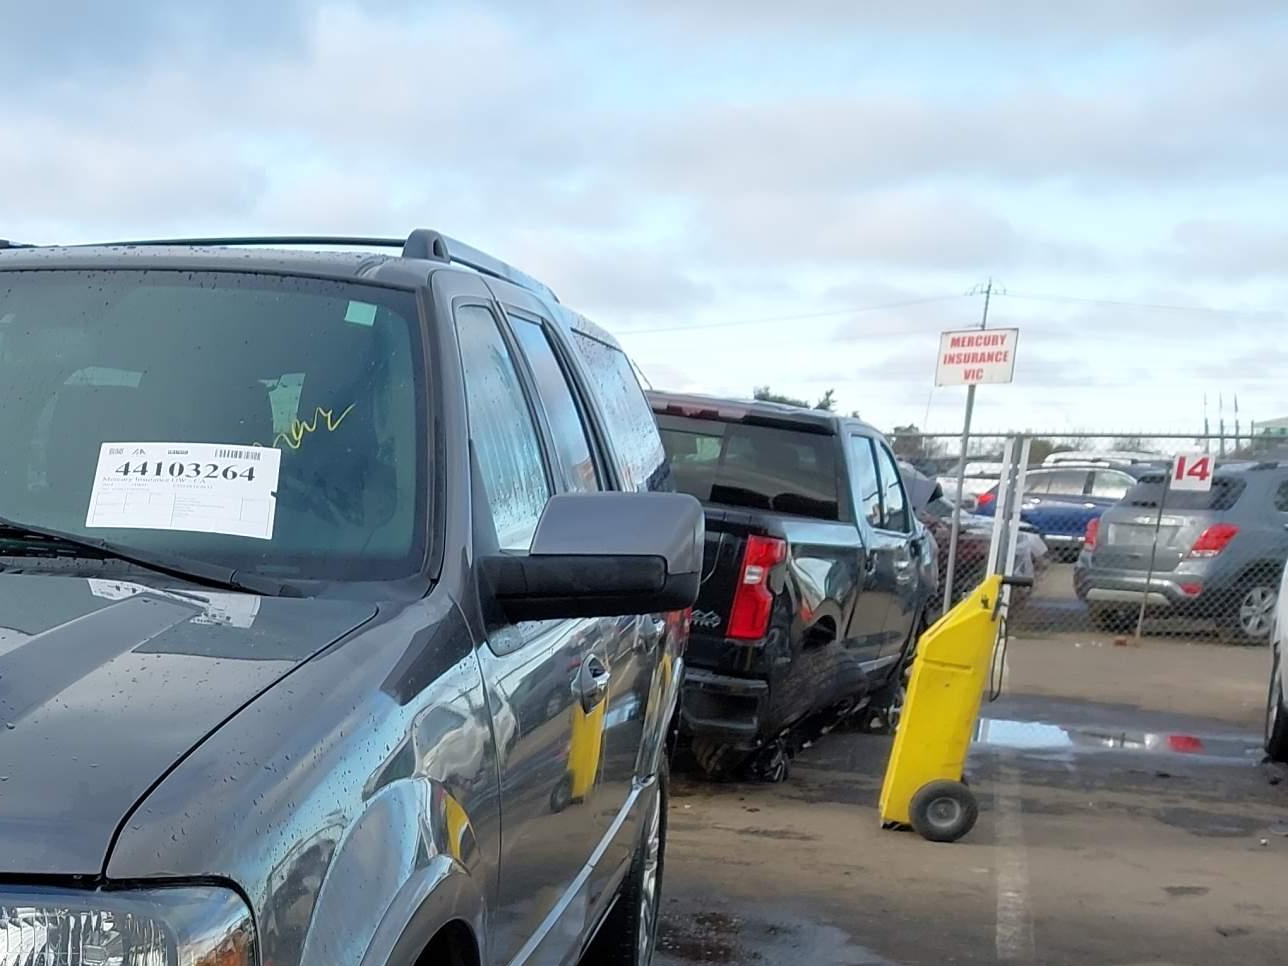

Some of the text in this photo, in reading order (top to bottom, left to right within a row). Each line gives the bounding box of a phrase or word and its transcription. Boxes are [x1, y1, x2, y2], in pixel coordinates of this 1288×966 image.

[950, 333, 1007, 348] MERCURY
[942, 350, 1009, 365] INSURANCE
[964, 368, 984, 381] VIC
[115, 461, 256, 482] 44103264
[1175, 456, 1210, 480] 14
